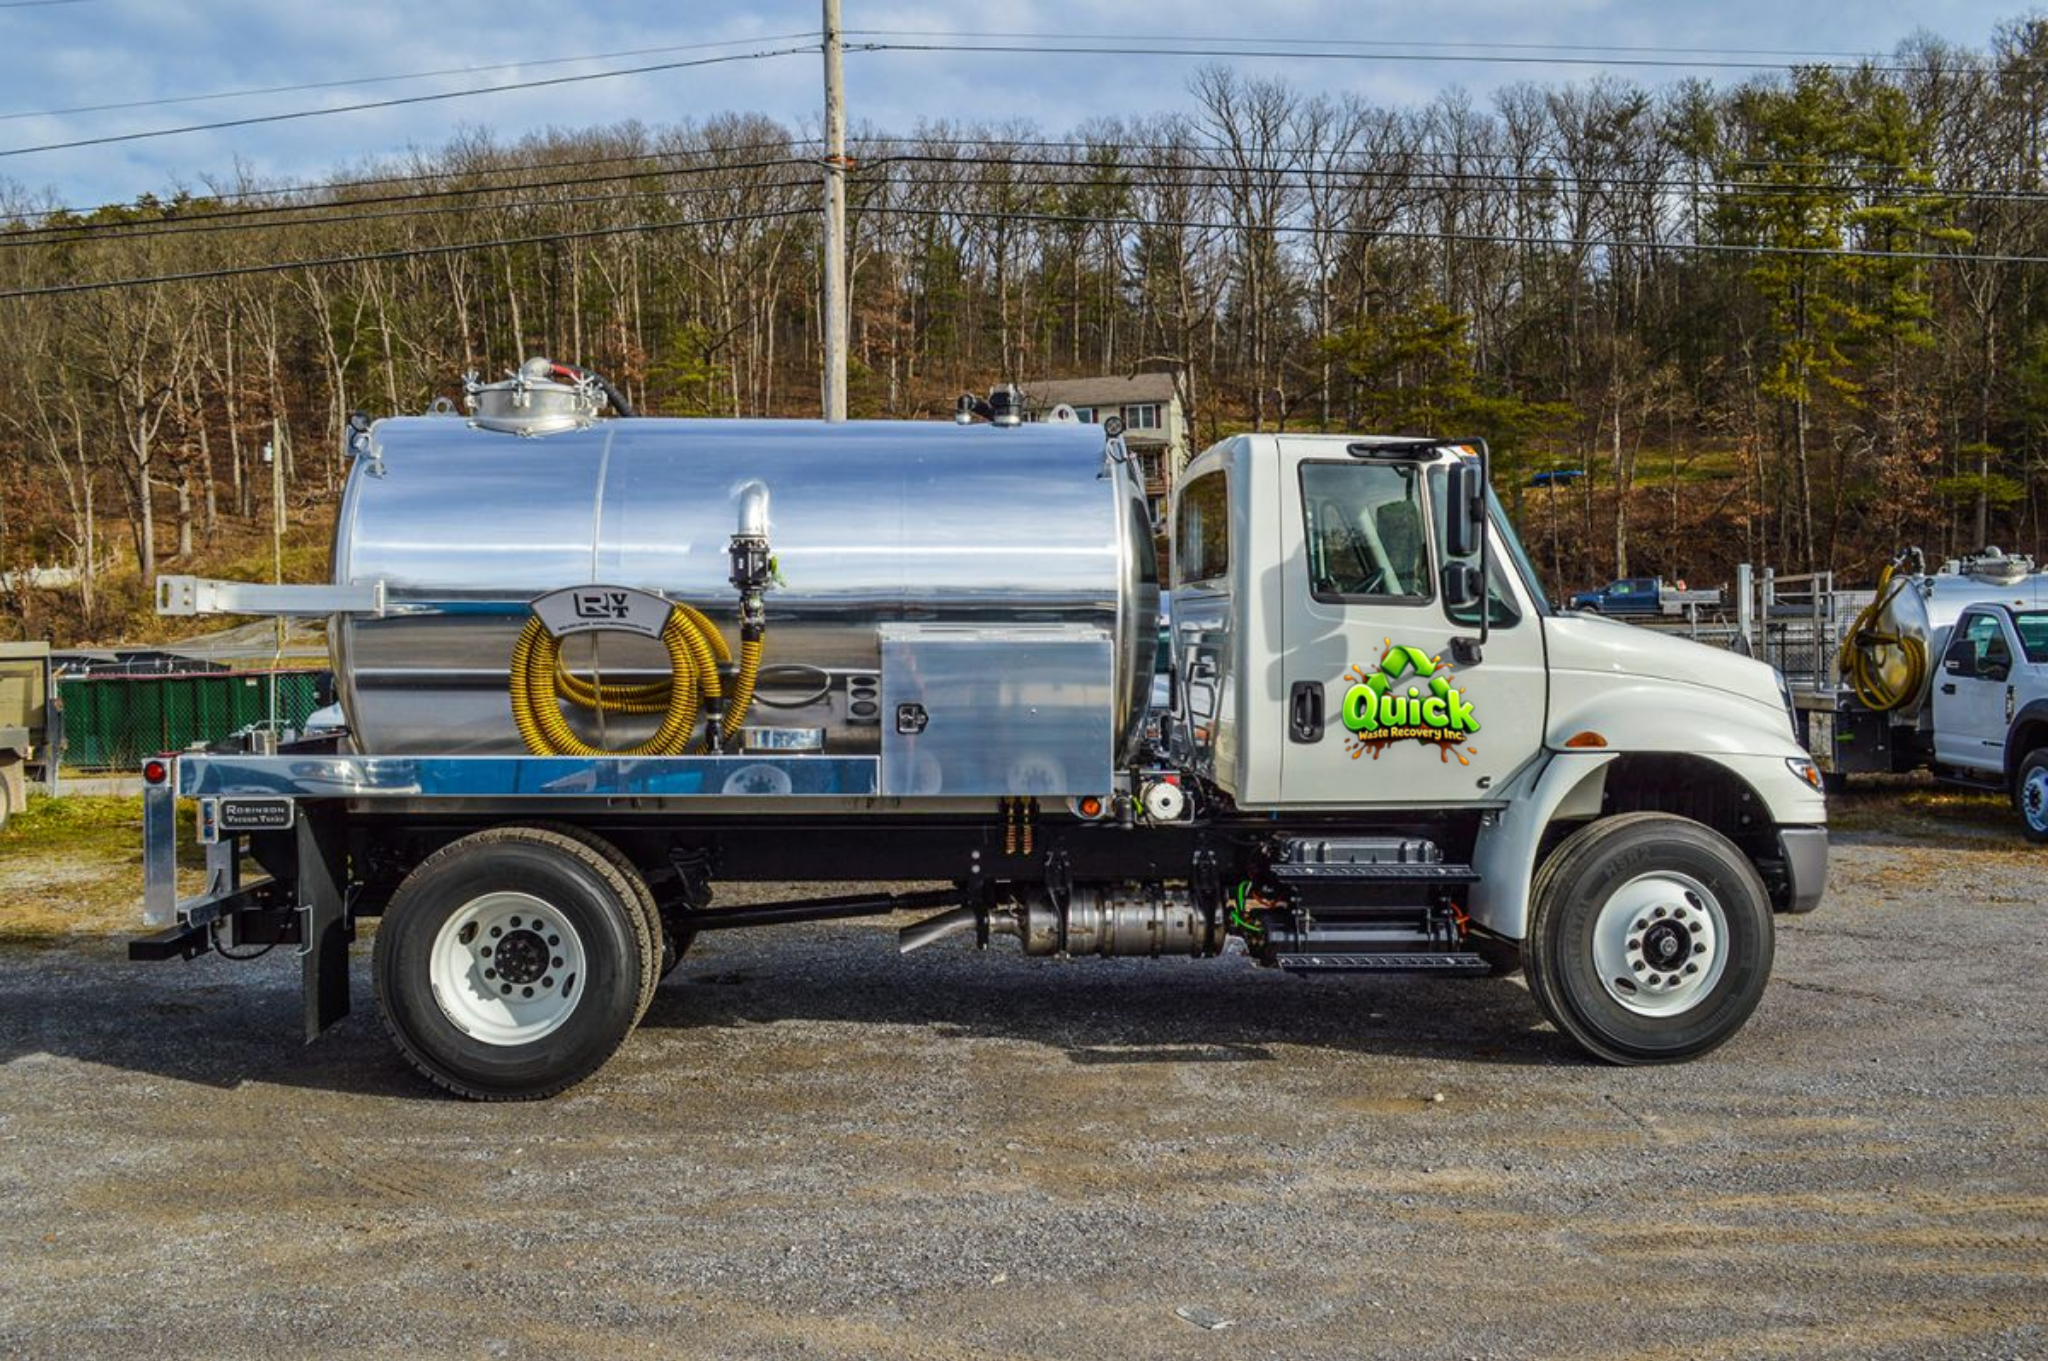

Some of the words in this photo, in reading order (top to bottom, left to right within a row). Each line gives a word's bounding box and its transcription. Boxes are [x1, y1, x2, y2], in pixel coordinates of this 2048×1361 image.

[1342, 682, 1481, 734] Quick
[1358, 728, 1389, 741] Waste
[1390, 726, 1442, 740] Recovery
[1443, 728, 1467, 741] Inc.
